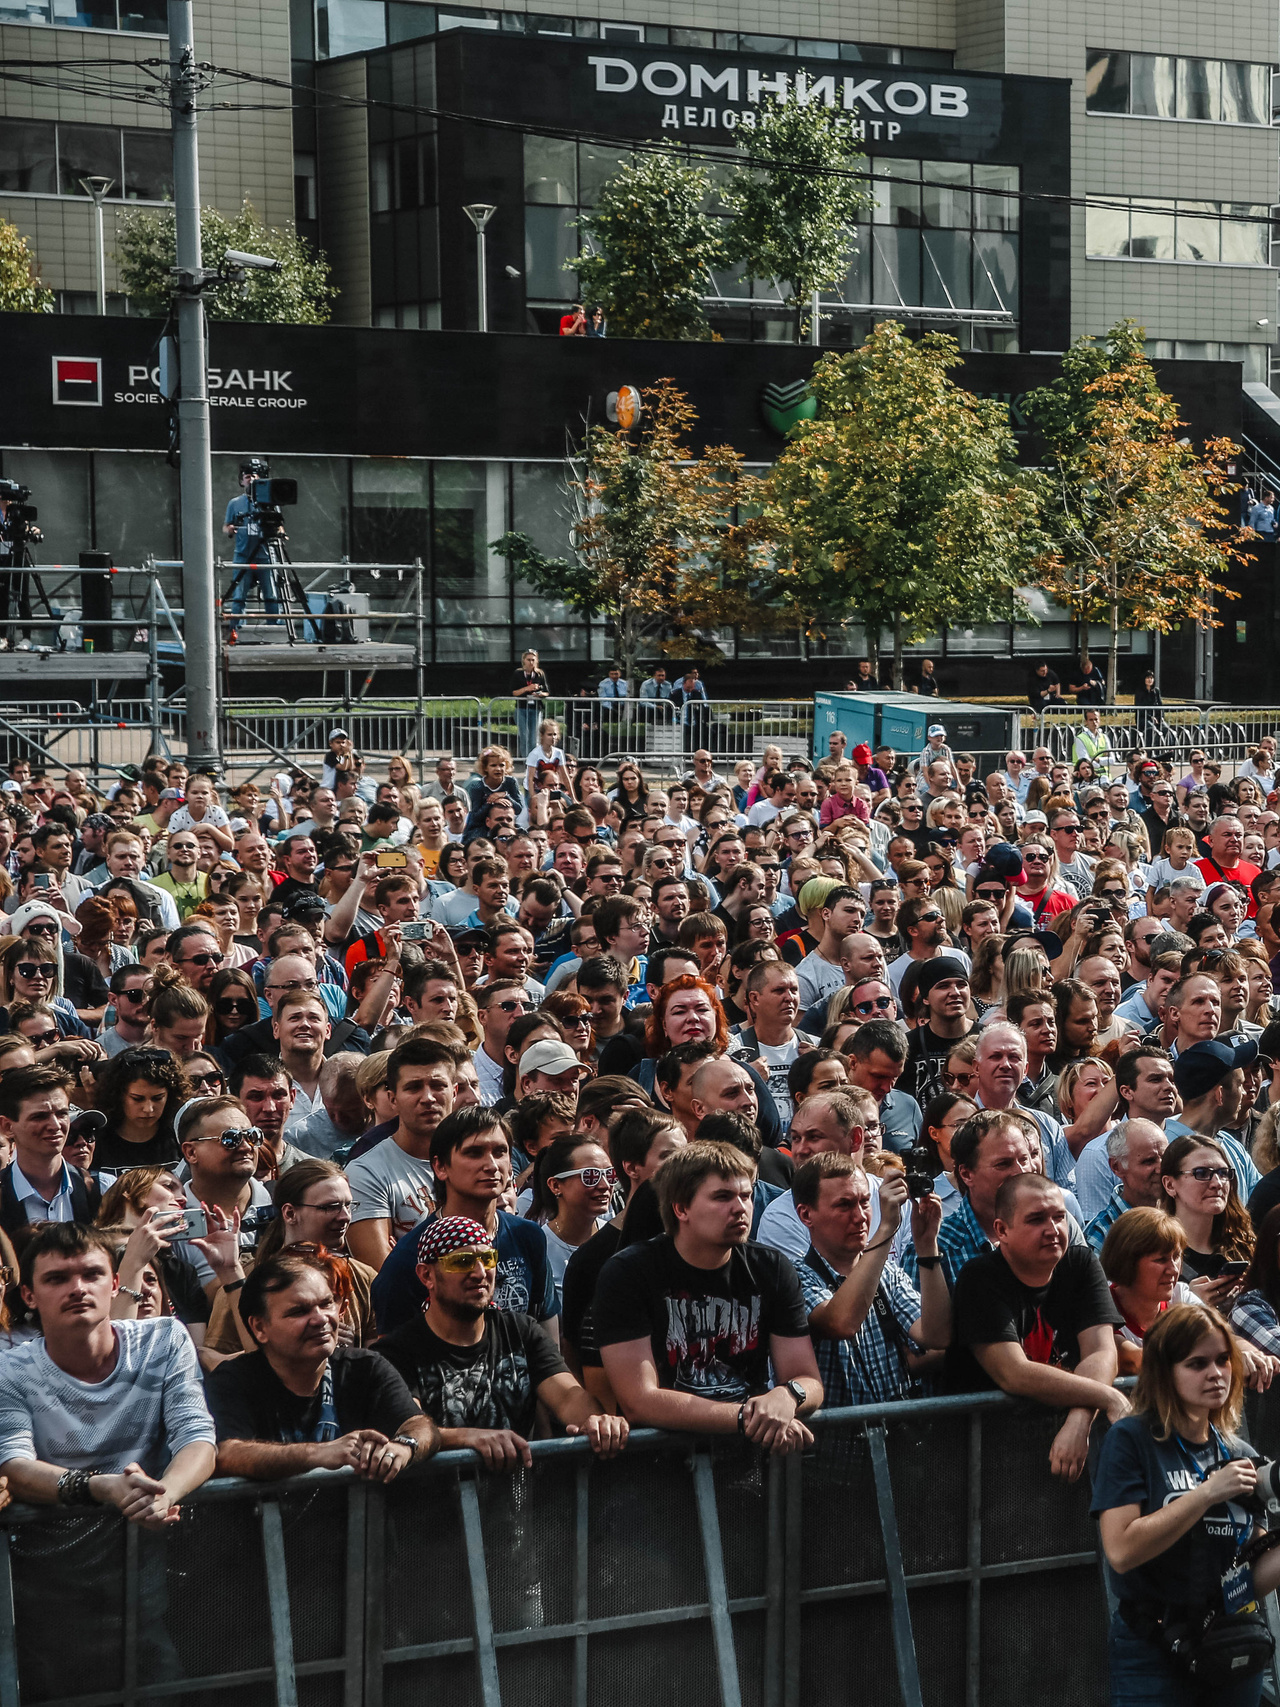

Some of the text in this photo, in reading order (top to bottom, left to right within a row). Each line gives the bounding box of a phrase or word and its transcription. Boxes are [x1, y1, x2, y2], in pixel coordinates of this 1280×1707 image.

[661, 104, 902, 141] ДЕЛОВ ЕНТР
[128, 365, 293, 391] РБАНК
[257, 397, 307, 408] GROUP
[876, 1298, 887, 1315] EOS
